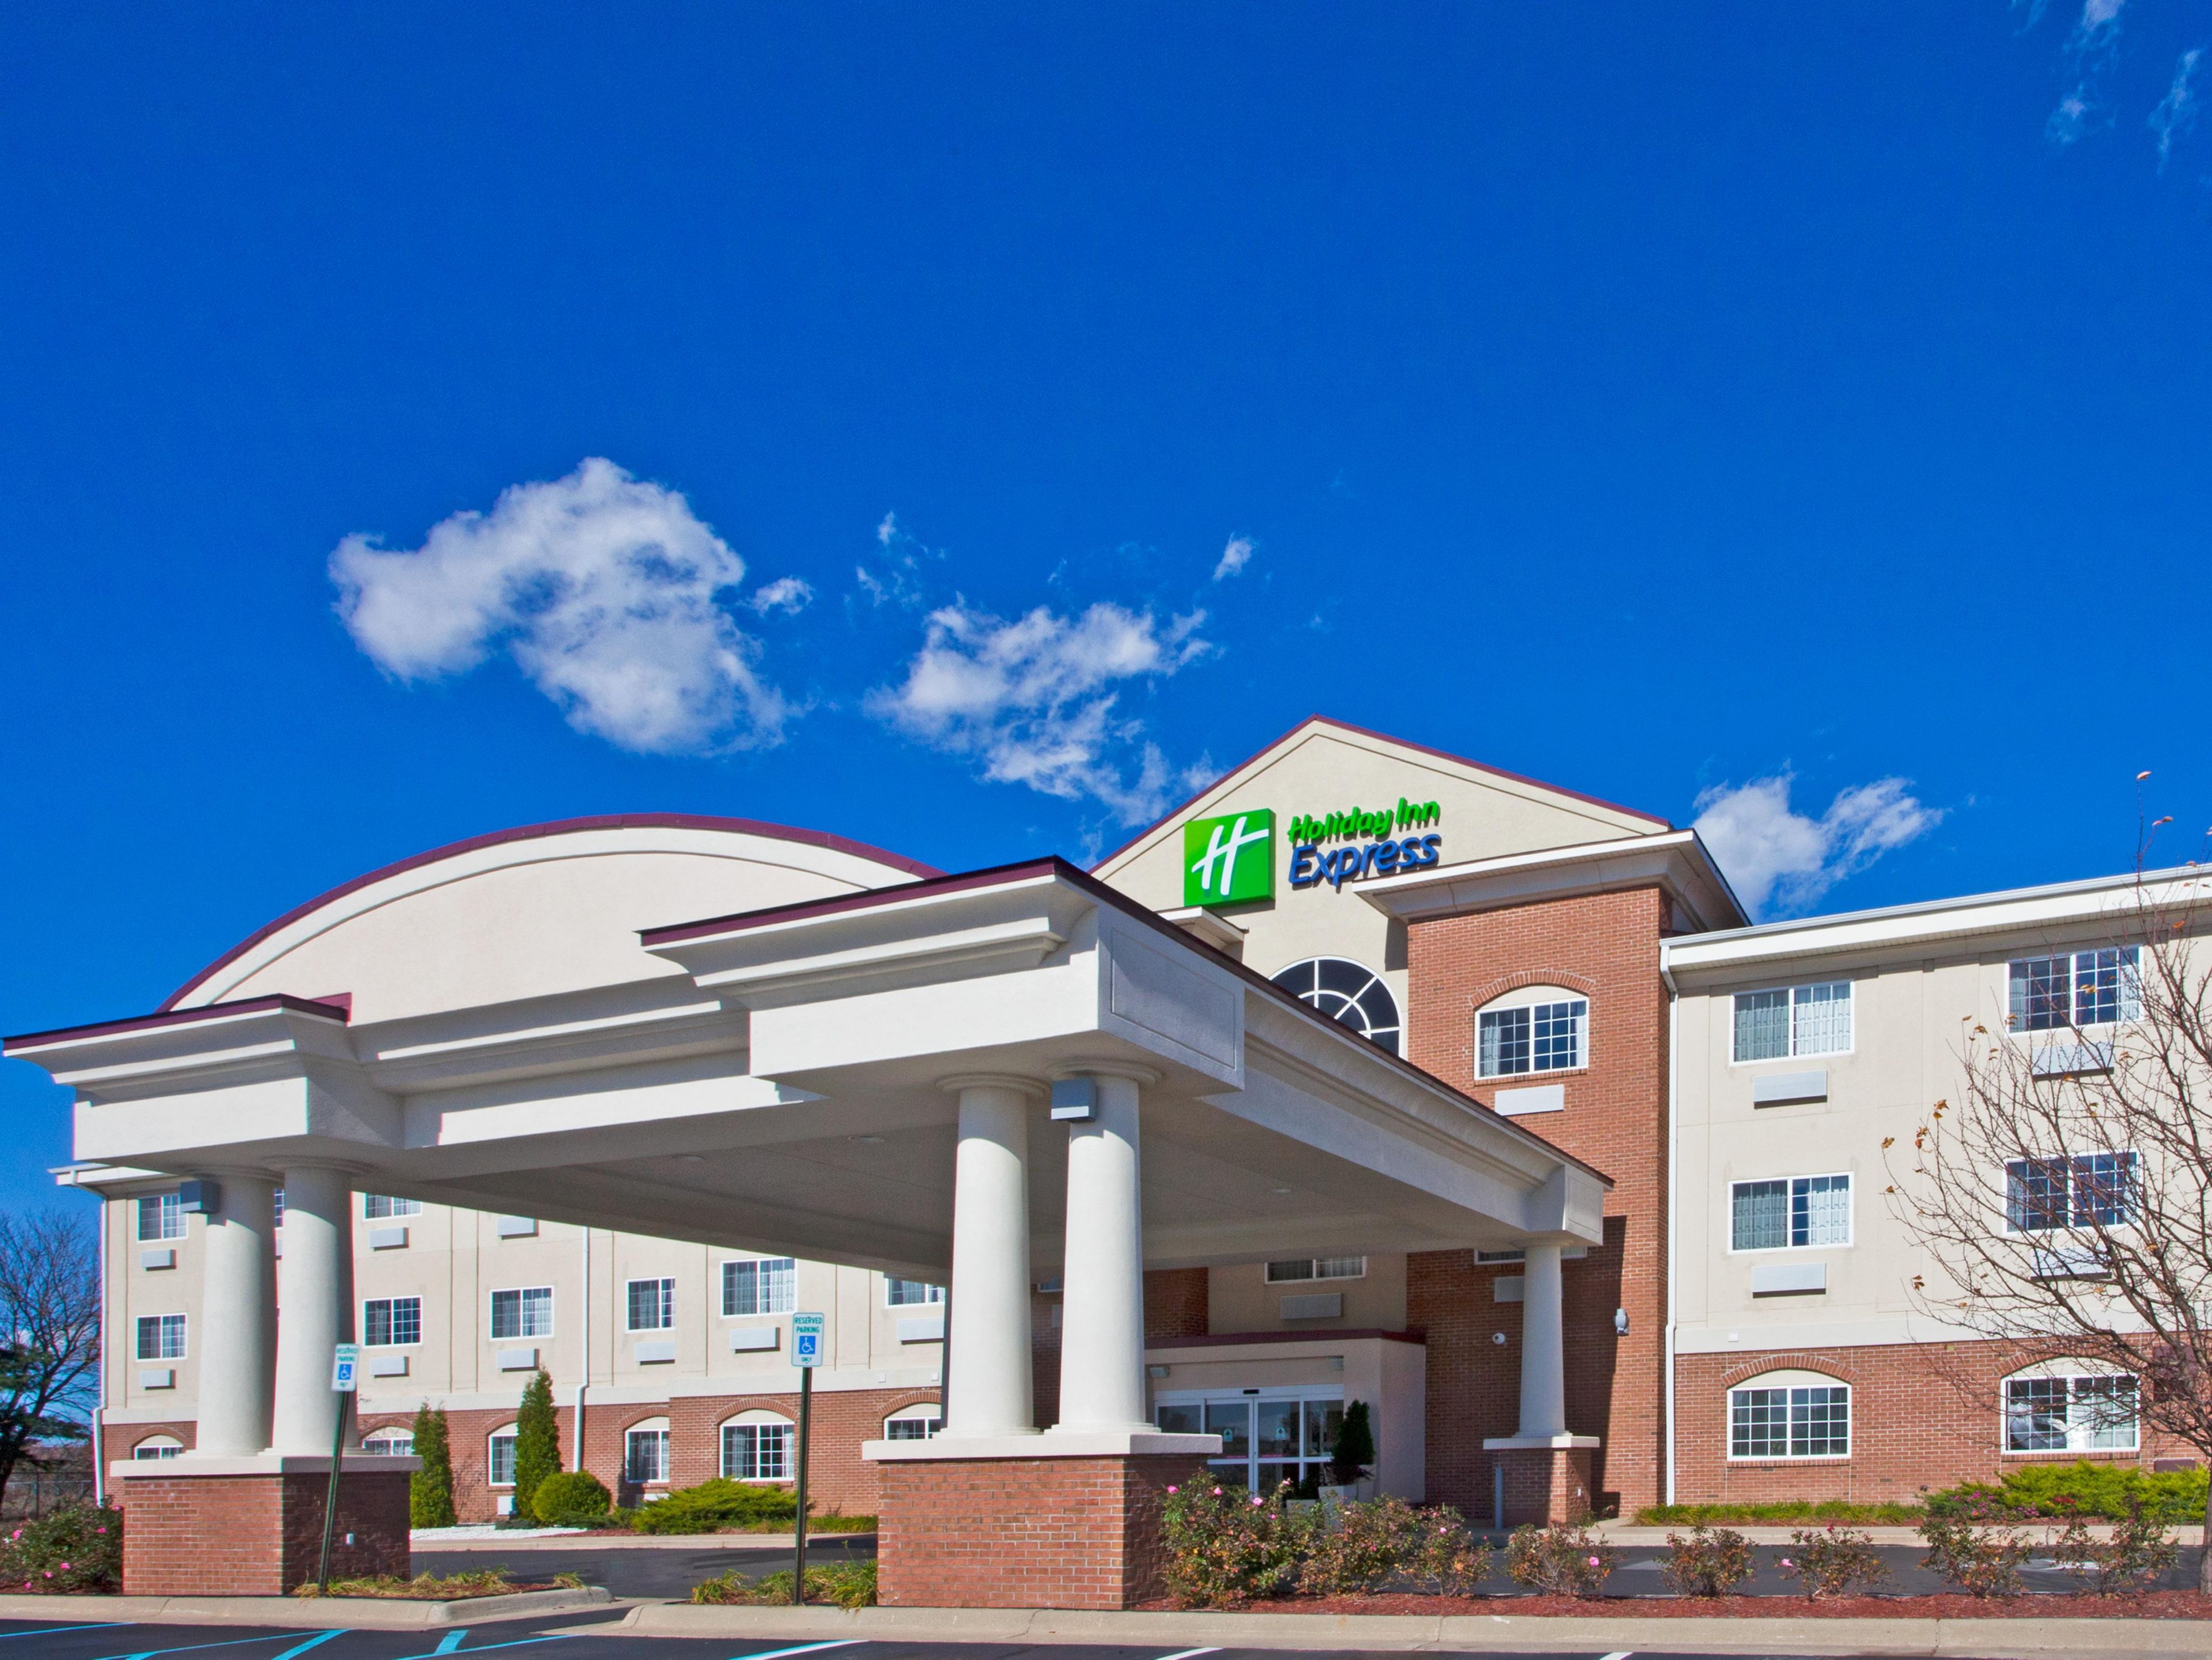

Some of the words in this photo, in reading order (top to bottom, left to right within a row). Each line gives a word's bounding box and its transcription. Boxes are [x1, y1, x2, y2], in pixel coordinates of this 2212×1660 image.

[1287, 806, 1394, 844] Holiday
[1395, 797, 1439, 826] Inn
[1288, 834, 1441, 886] Express
